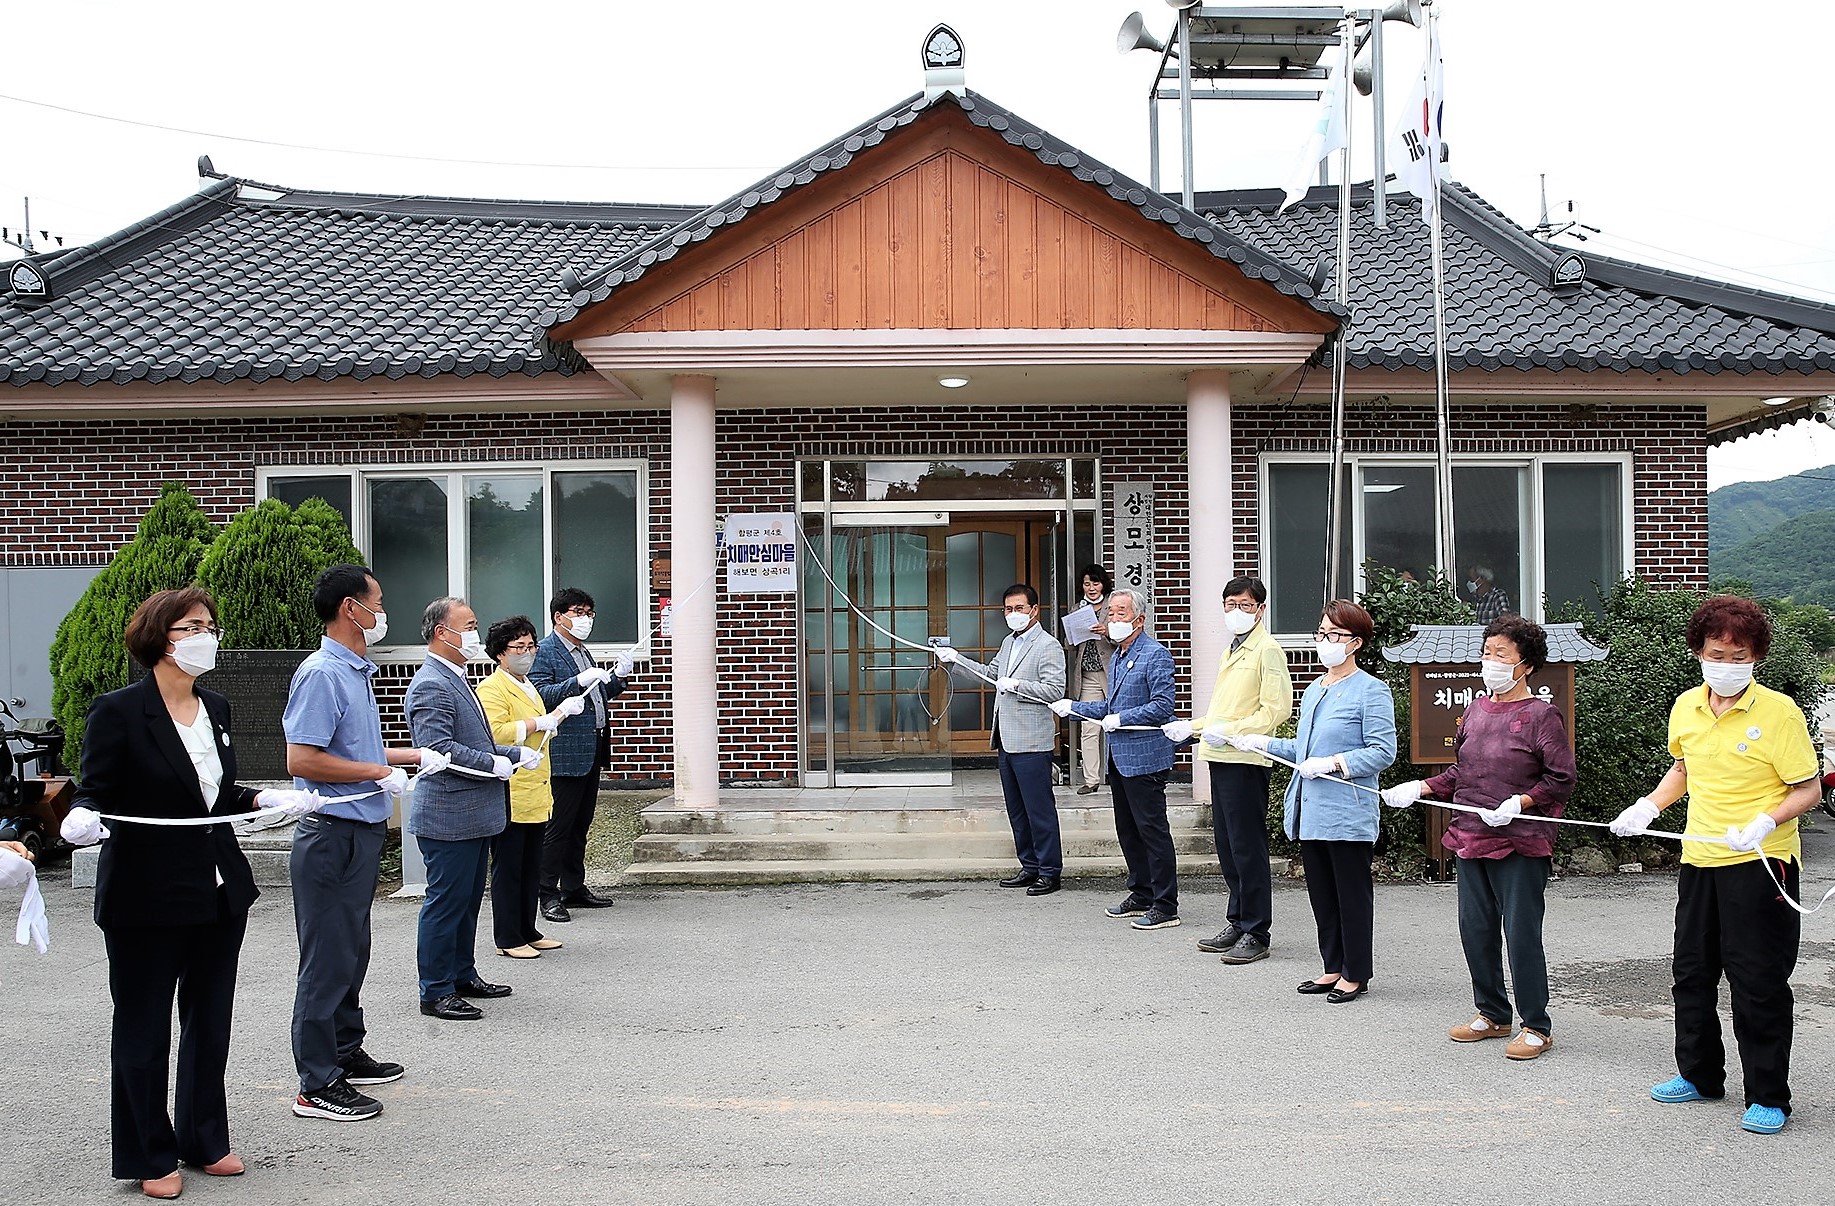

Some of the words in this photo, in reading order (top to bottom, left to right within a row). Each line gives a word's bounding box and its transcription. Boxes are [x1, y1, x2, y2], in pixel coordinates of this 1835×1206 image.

[738, 529, 759, 537] 함평군
[763, 529, 783, 537] 제4호
[727, 544, 795, 563] 치매안심마을
[732, 567, 758, 577] 해보면
[761, 567, 791, 577] 상곡1리
[311, 1097, 359, 1114] DYNAFIT
